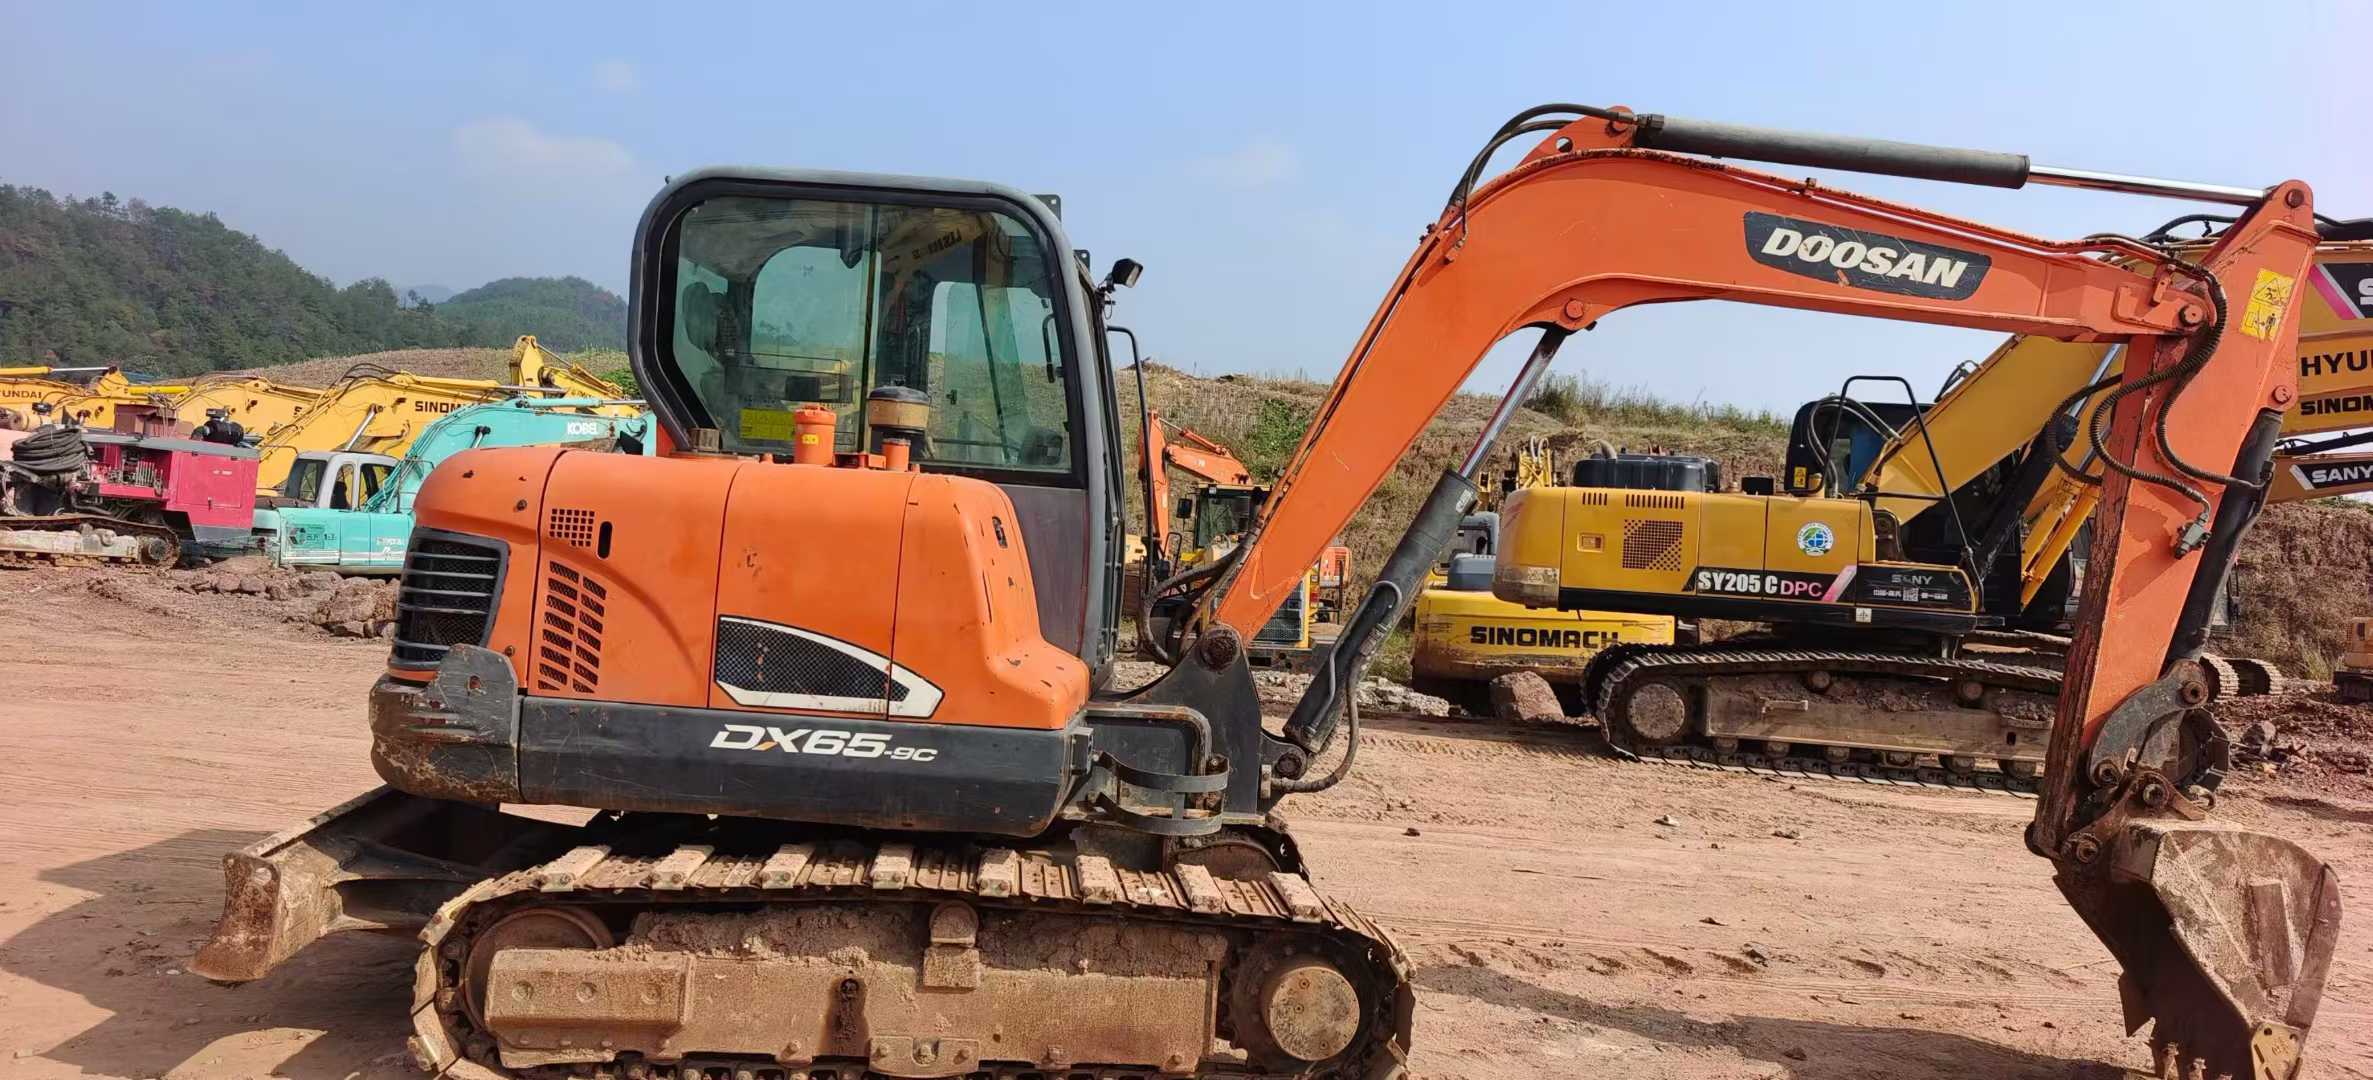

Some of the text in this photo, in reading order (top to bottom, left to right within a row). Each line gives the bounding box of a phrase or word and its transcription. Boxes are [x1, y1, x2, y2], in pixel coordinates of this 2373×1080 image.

[1761, 227, 1969, 288] DOOSAN
[2301, 350, 2373, 377] HYU
[0, 390, 42, 399] UNDAI
[2312, 464, 2373, 483] SANY
[1698, 571, 1761, 593] SY205
[1780, 580, 1823, 597] DPC
[1470, 626, 1618, 649] SINOMACH
[709, 723, 938, 762] DX65-9C
